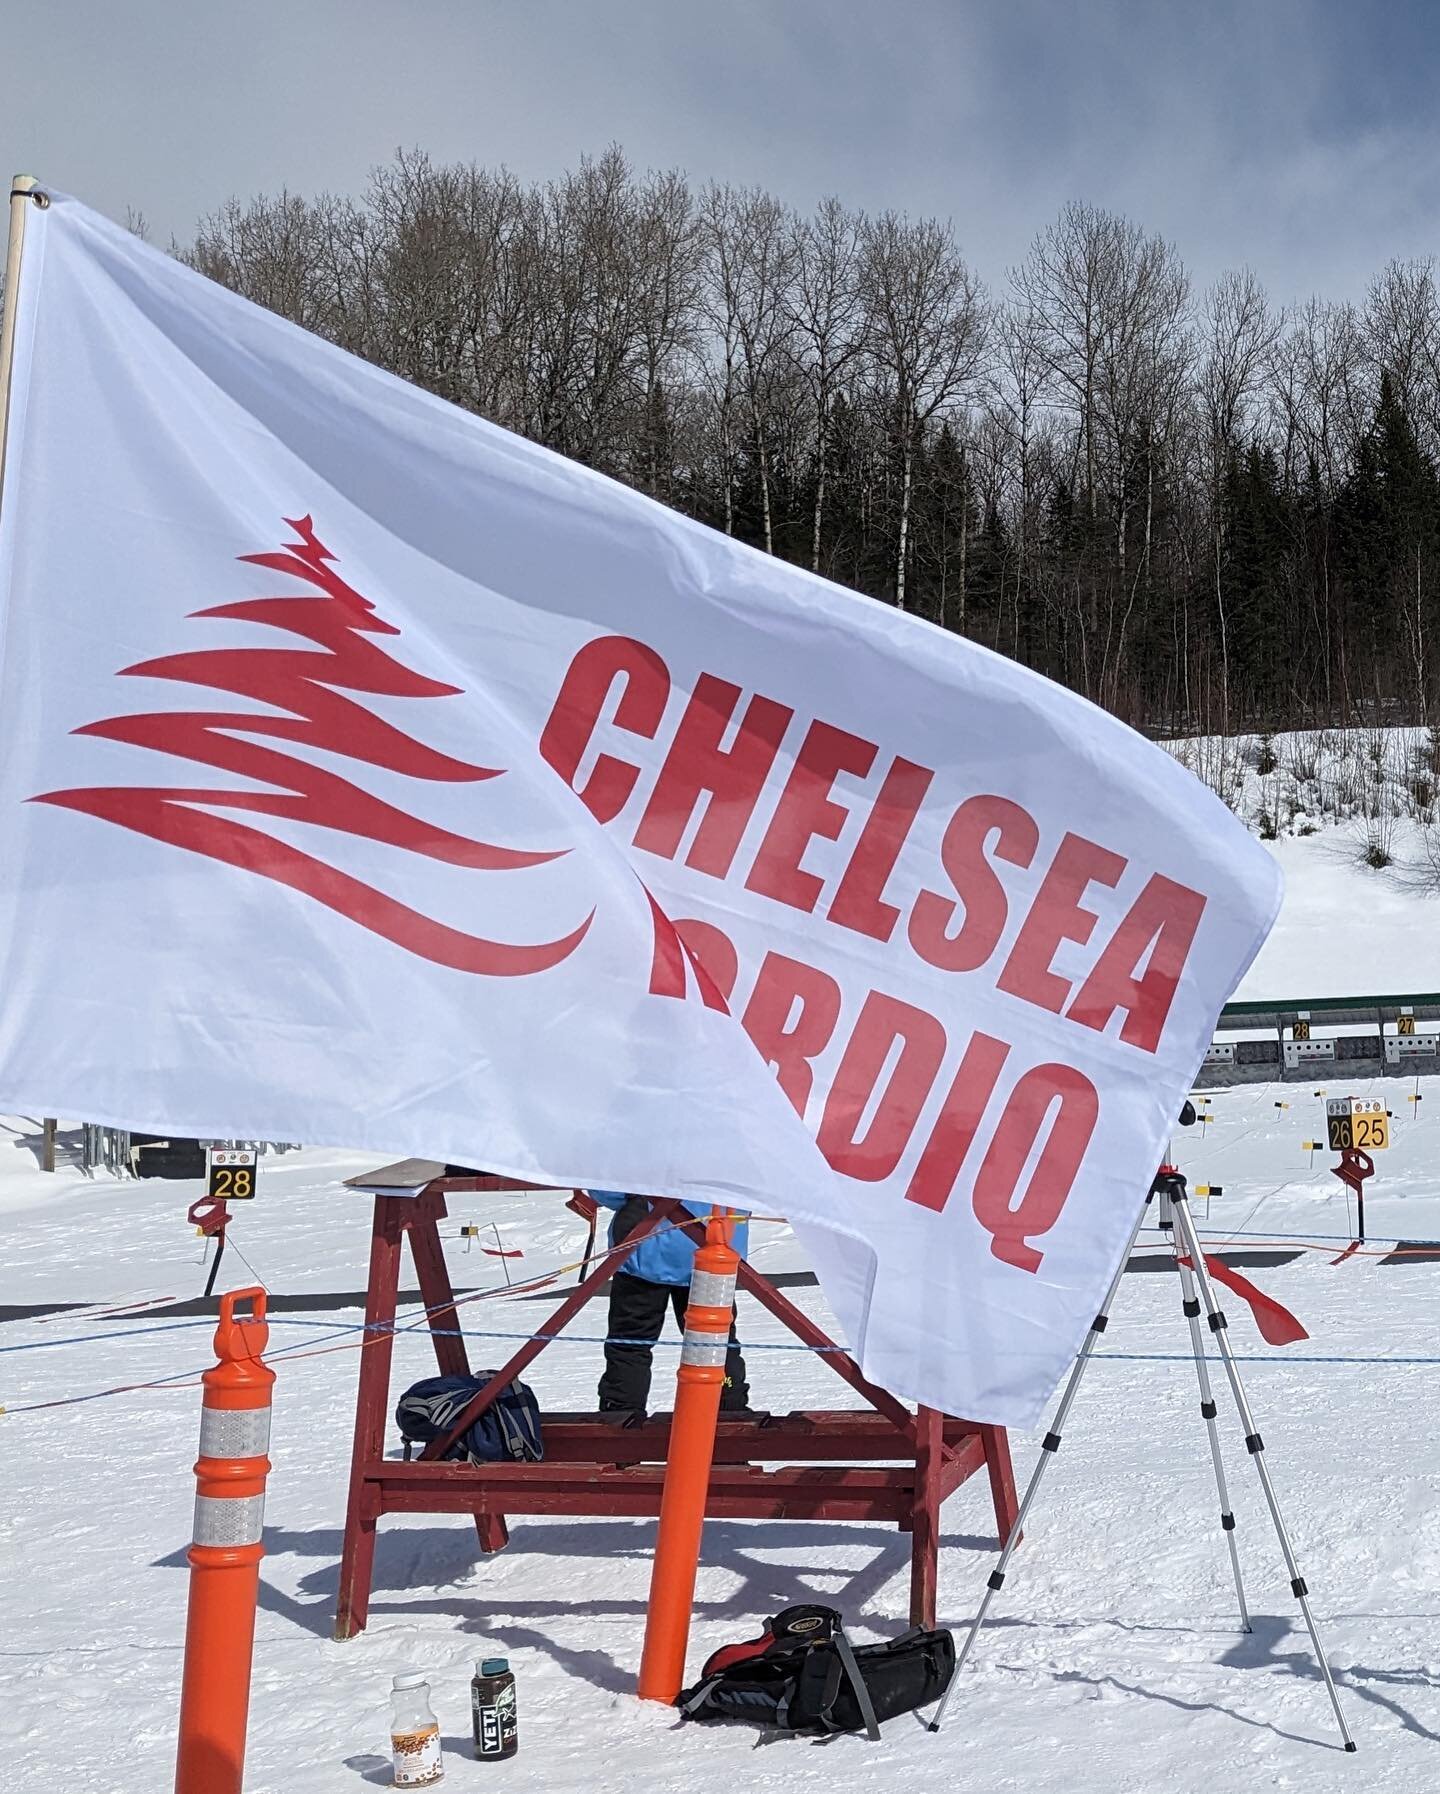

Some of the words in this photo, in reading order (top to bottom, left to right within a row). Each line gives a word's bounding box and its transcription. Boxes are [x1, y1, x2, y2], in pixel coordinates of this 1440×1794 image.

[540, 635, 1208, 1054] CHELSEA
[1294, 1023, 1309, 1040] 28
[1399, 1018, 1413, 1034] 27
[1330, 1120, 1351, 1148] 26
[1356, 1118, 1384, 1147] 25
[214, 1169, 251, 1197] 28
